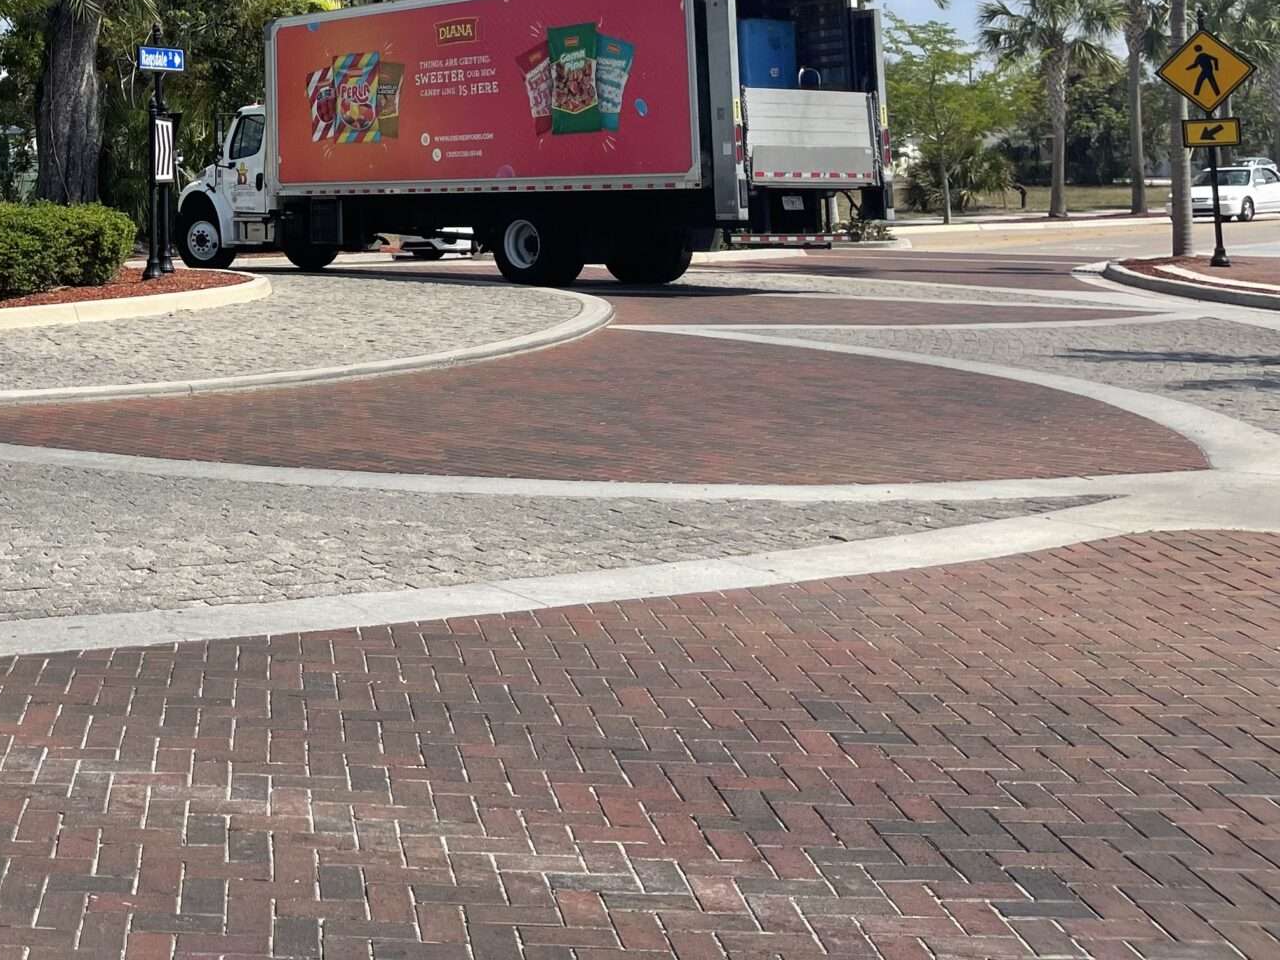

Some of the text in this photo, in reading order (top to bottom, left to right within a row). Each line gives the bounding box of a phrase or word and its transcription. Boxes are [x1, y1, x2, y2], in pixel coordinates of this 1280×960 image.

[439, 24, 473, 39] DIANA
[414, 69, 465, 86] SWEETER
[458, 84, 468, 96] IS
[470, 81, 499, 95] HERE
